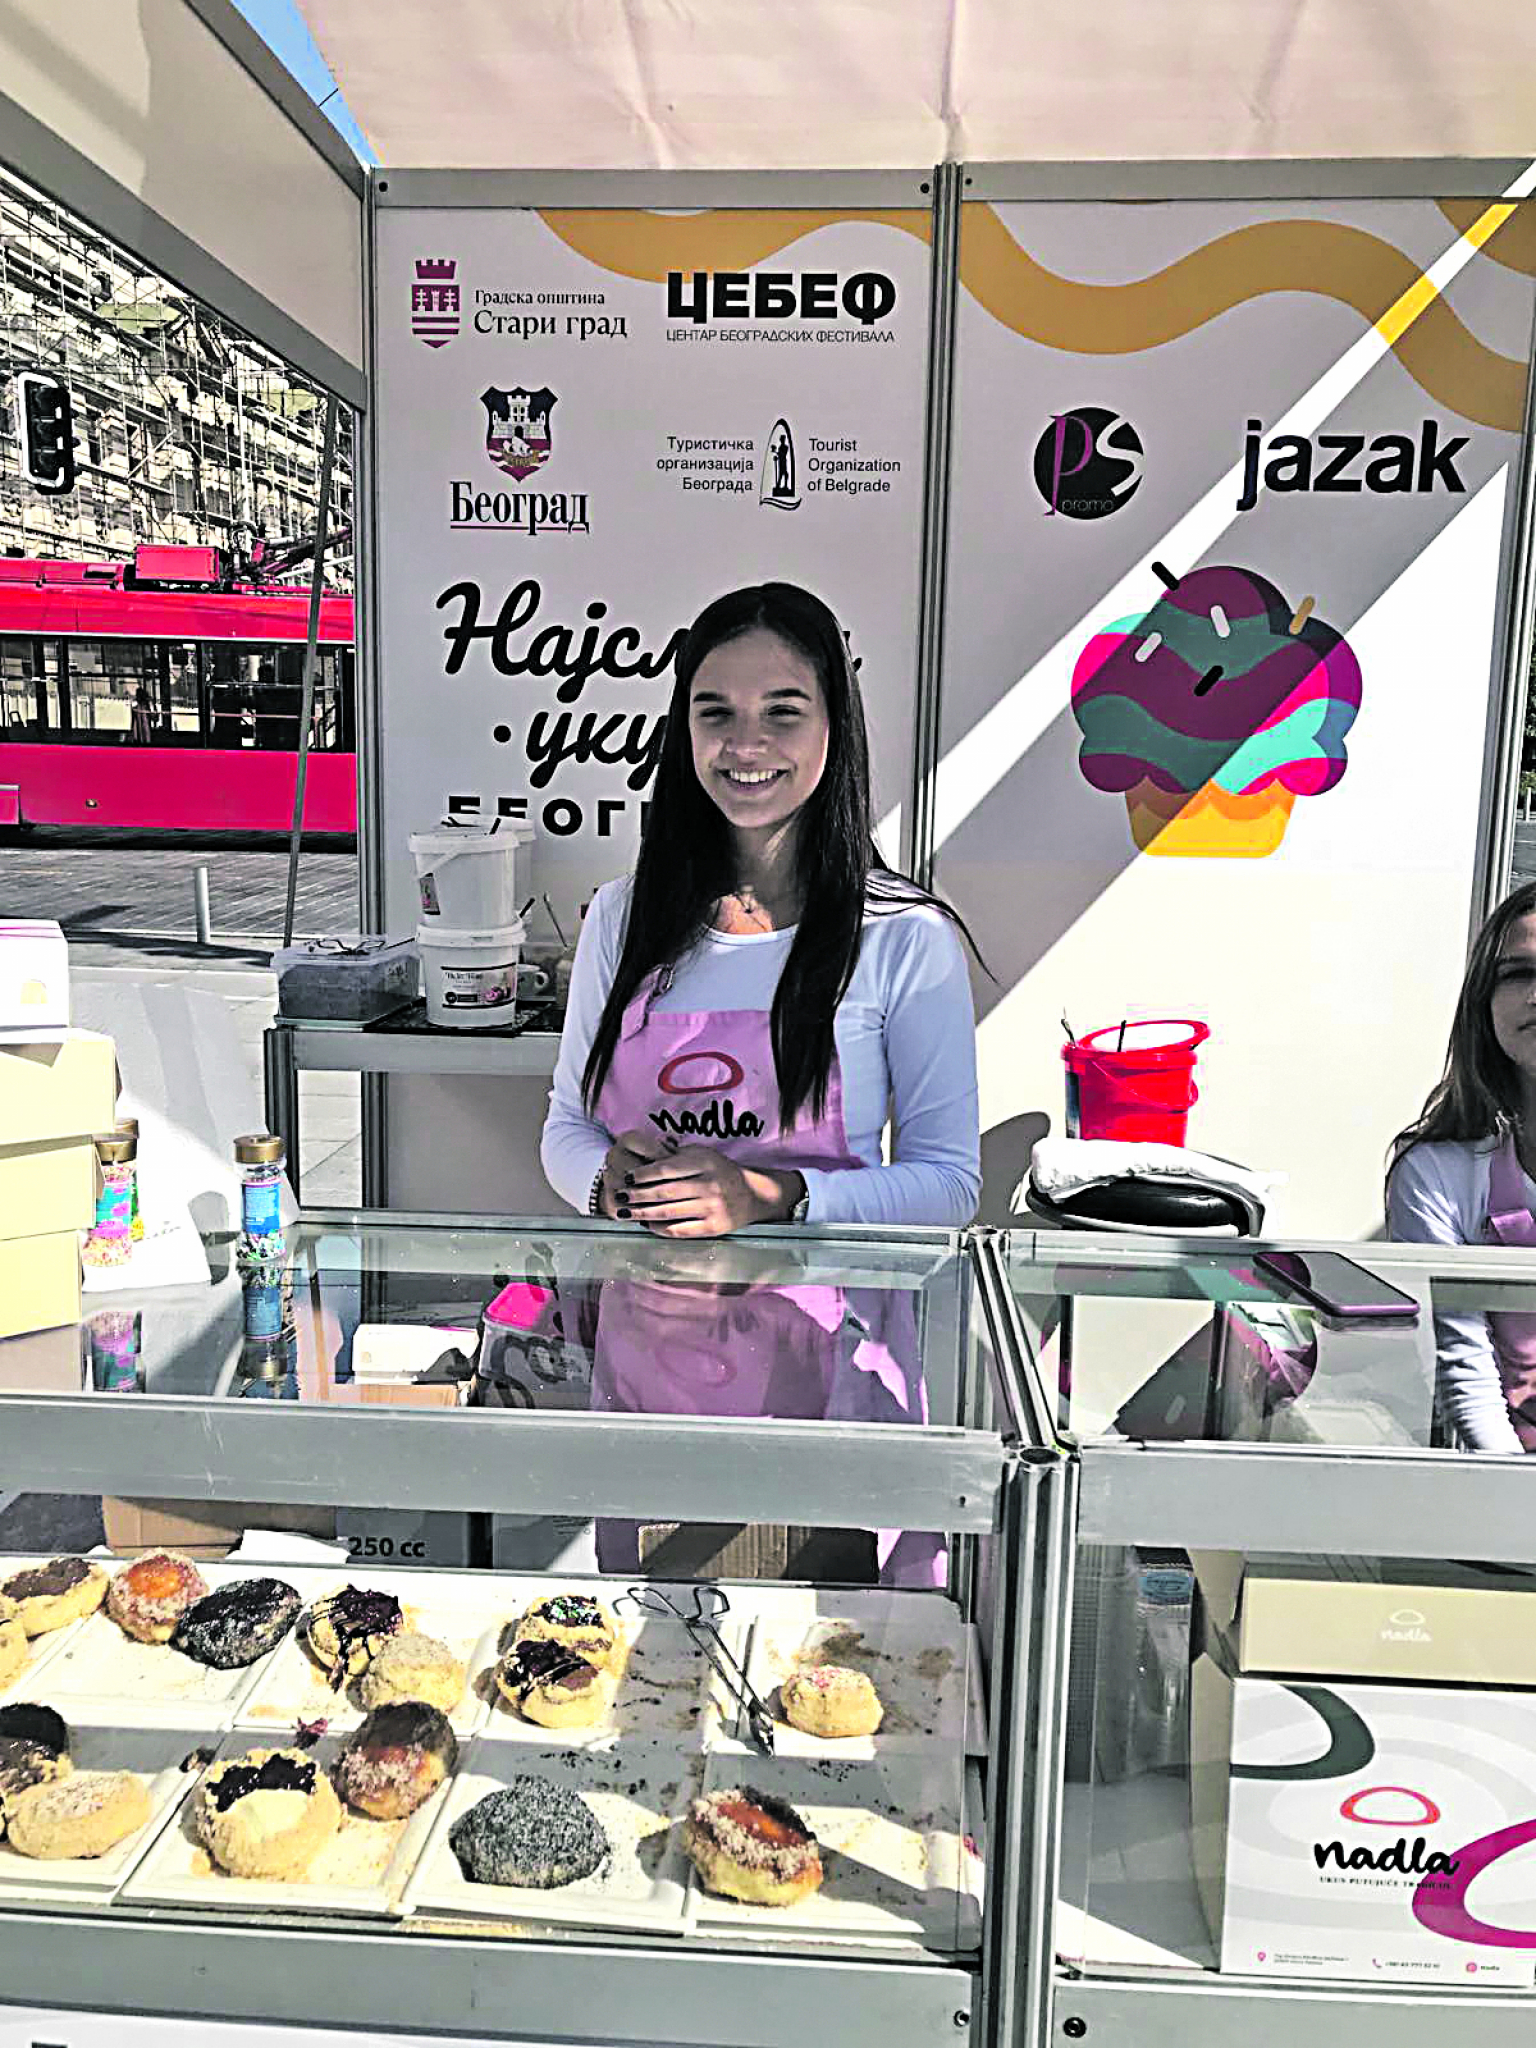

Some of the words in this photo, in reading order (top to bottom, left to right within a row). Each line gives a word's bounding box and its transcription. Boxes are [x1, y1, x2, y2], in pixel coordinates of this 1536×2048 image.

[474, 289, 534, 306] Градска
[536, 292, 606, 305] општина
[666, 271, 896, 325] ЦЕБЕФ
[473, 309, 557, 340] Стари
[565, 316, 628, 341] град
[665, 328, 718, 342] ЦЕНТАР
[719, 329, 813, 343] БЕОГРАДСКИХ
[815, 330, 895, 343] ФЕСТИВАЛА
[666, 435, 755, 453] Туристичка
[808, 438, 858, 452] Tourist
[656, 457, 755, 473] организација
[807, 457, 901, 475] Organization
[1236, 419, 1471, 512] jazak
[682, 476, 754, 494] Београда
[806, 478, 822, 492] of
[824, 478, 891, 495] Belgrade
[449, 480, 590, 536] Београд
[1061, 499, 1116, 513] promo
[648, 1098, 765, 1140] nadla
[349, 1536, 394, 1558] 250
[400, 1540, 426, 1558] cc
[1313, 1836, 1461, 1877] nadla
